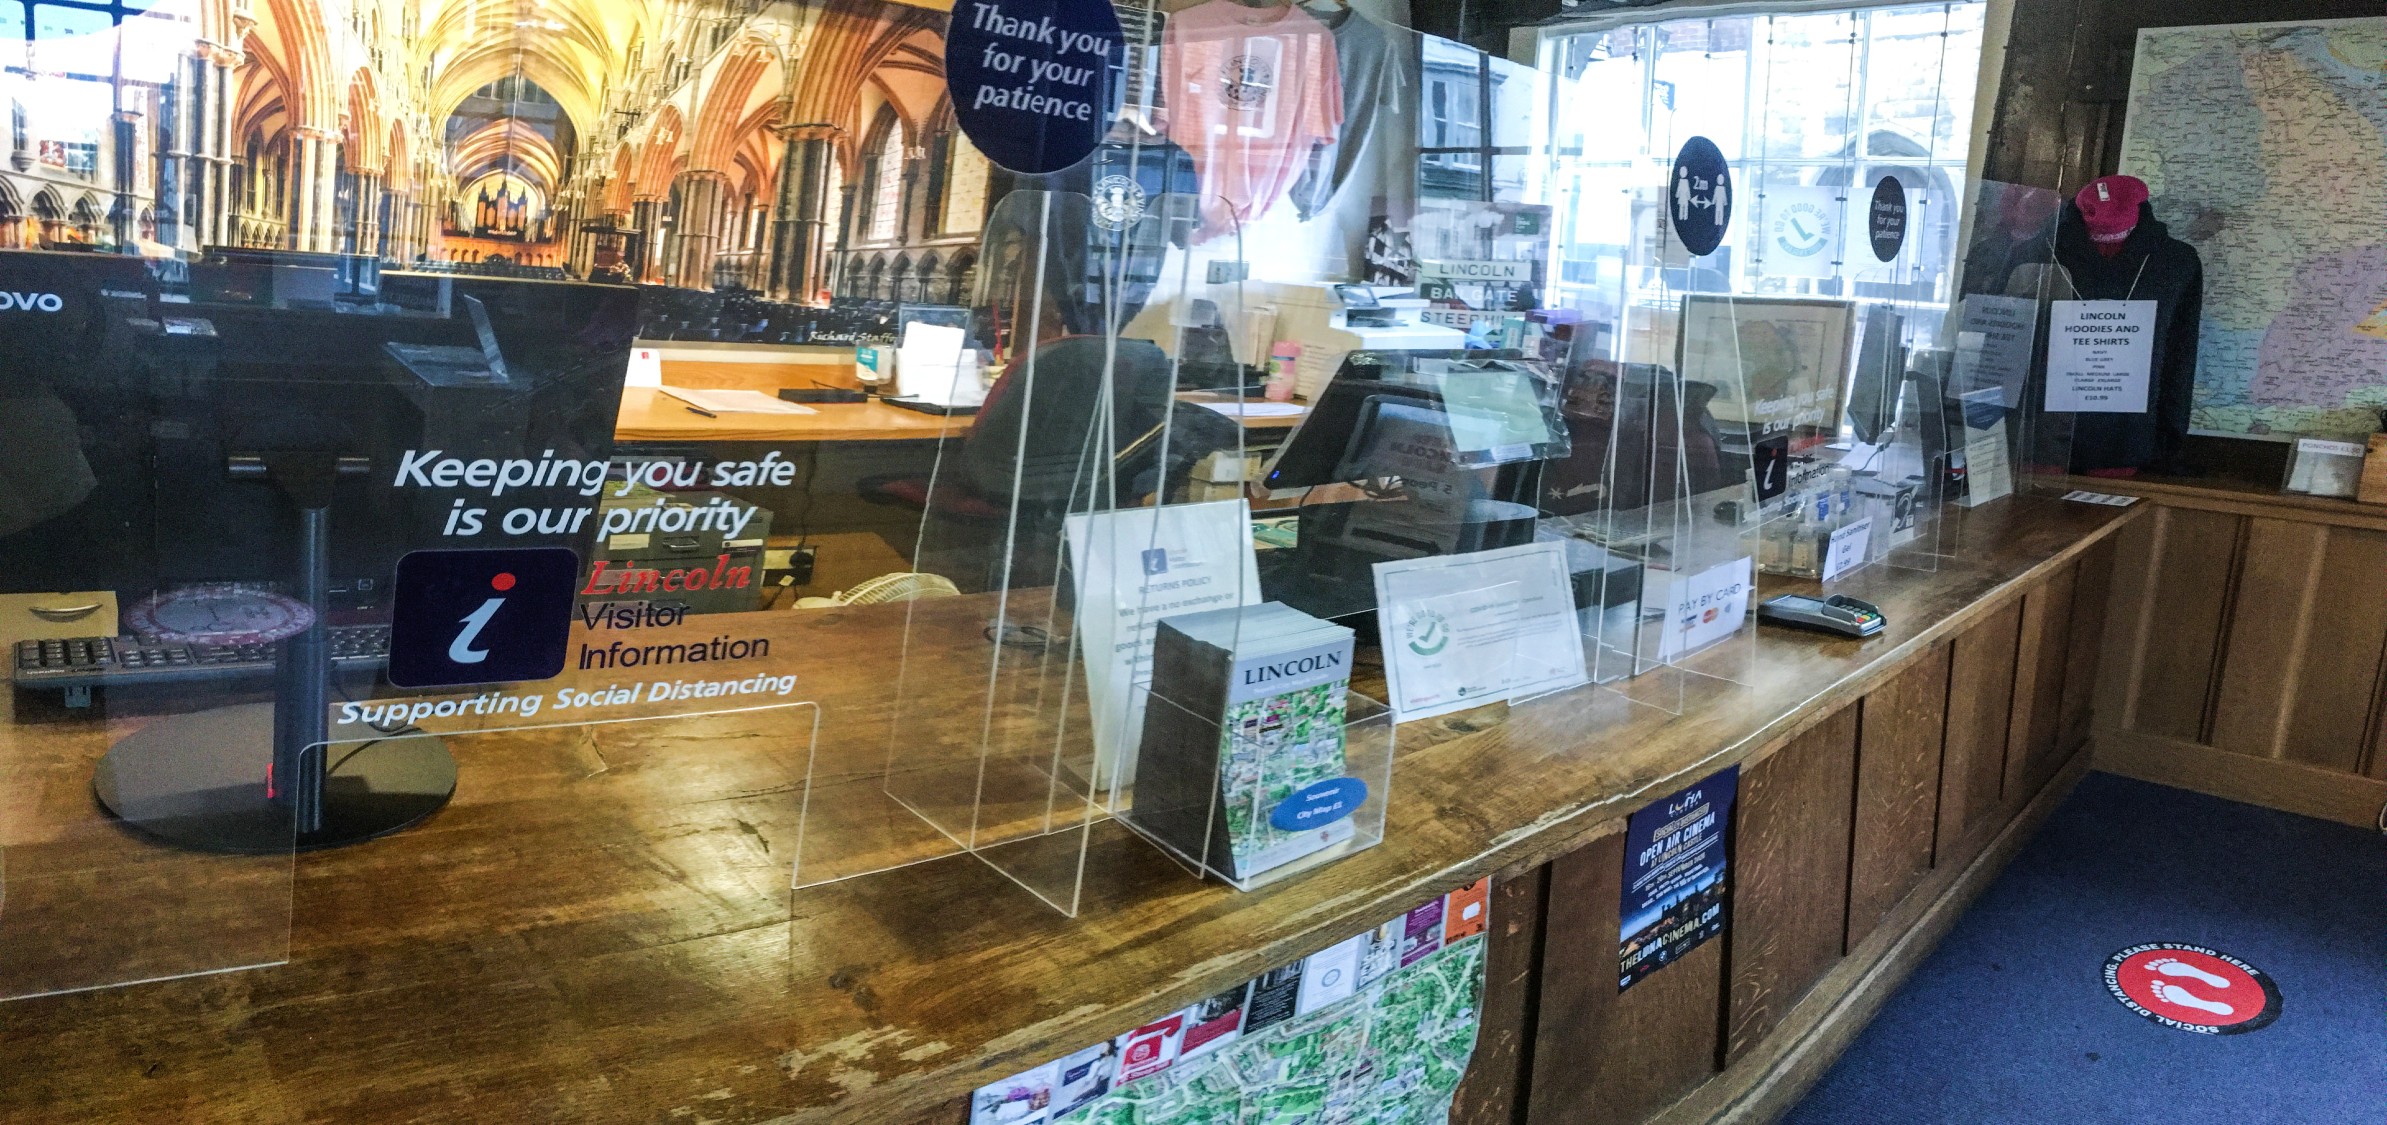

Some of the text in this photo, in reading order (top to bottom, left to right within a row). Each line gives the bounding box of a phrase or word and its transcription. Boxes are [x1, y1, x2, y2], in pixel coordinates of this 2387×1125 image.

[972, 2, 1112, 57] Thank you
[983, 42, 1095, 87] for your
[973, 84, 1092, 121] patience
[1692, 176, 1709, 191] 2m
[1874, 200, 1904, 215] Thank you
[1876, 216, 1900, 231] for your
[1874, 230, 1900, 242] patience
[1439, 263, 1516, 277] LINCOLN
[1420, 311, 1479, 325] STEEP
[2080, 312, 2126, 320] LINCOLN
[808, 331, 859, 343] Richard
[2064, 325, 2140, 333] HOODIES AND
[2072, 338, 2130, 346] TEE SHIRTS
[1754, 394, 1797, 417] Keeping
[1773, 417, 1792, 432] our
[1792, 407, 1826, 431] priority
[2302, 442, 2339, 451] PONCHOS
[394, 449, 797, 498] Keeping you safe
[442, 497, 758, 543] is our priority
[580, 554, 752, 597] Lincoln
[1138, 575, 1212, 594] RETURNS POLICY
[1678, 583, 1742, 615] PAY BY CARD
[581, 600, 691, 631] Visitor
[1119, 608, 1135, 617] We
[578, 635, 770, 671] Information
[1243, 650, 1342, 686] LINCOLN
[337, 672, 798, 727] Supporting Social Distancing
[1305, 787, 1341, 802] Souvenir
[1296, 810, 1313, 820] City
[1640, 839, 1663, 867] OPEN
[1665, 830, 1681, 852] AIR
[1683, 811, 1716, 842] CINEMA
[1620, 902, 1720, 974] THELUNACINEMA.COM
[2113, 943, 2160, 962] PLEASE
[2162, 943, 2217, 956] STAND
[2219, 954, 2260, 977] HERE
[2156, 1014, 2220, 1034] SOCIAL
